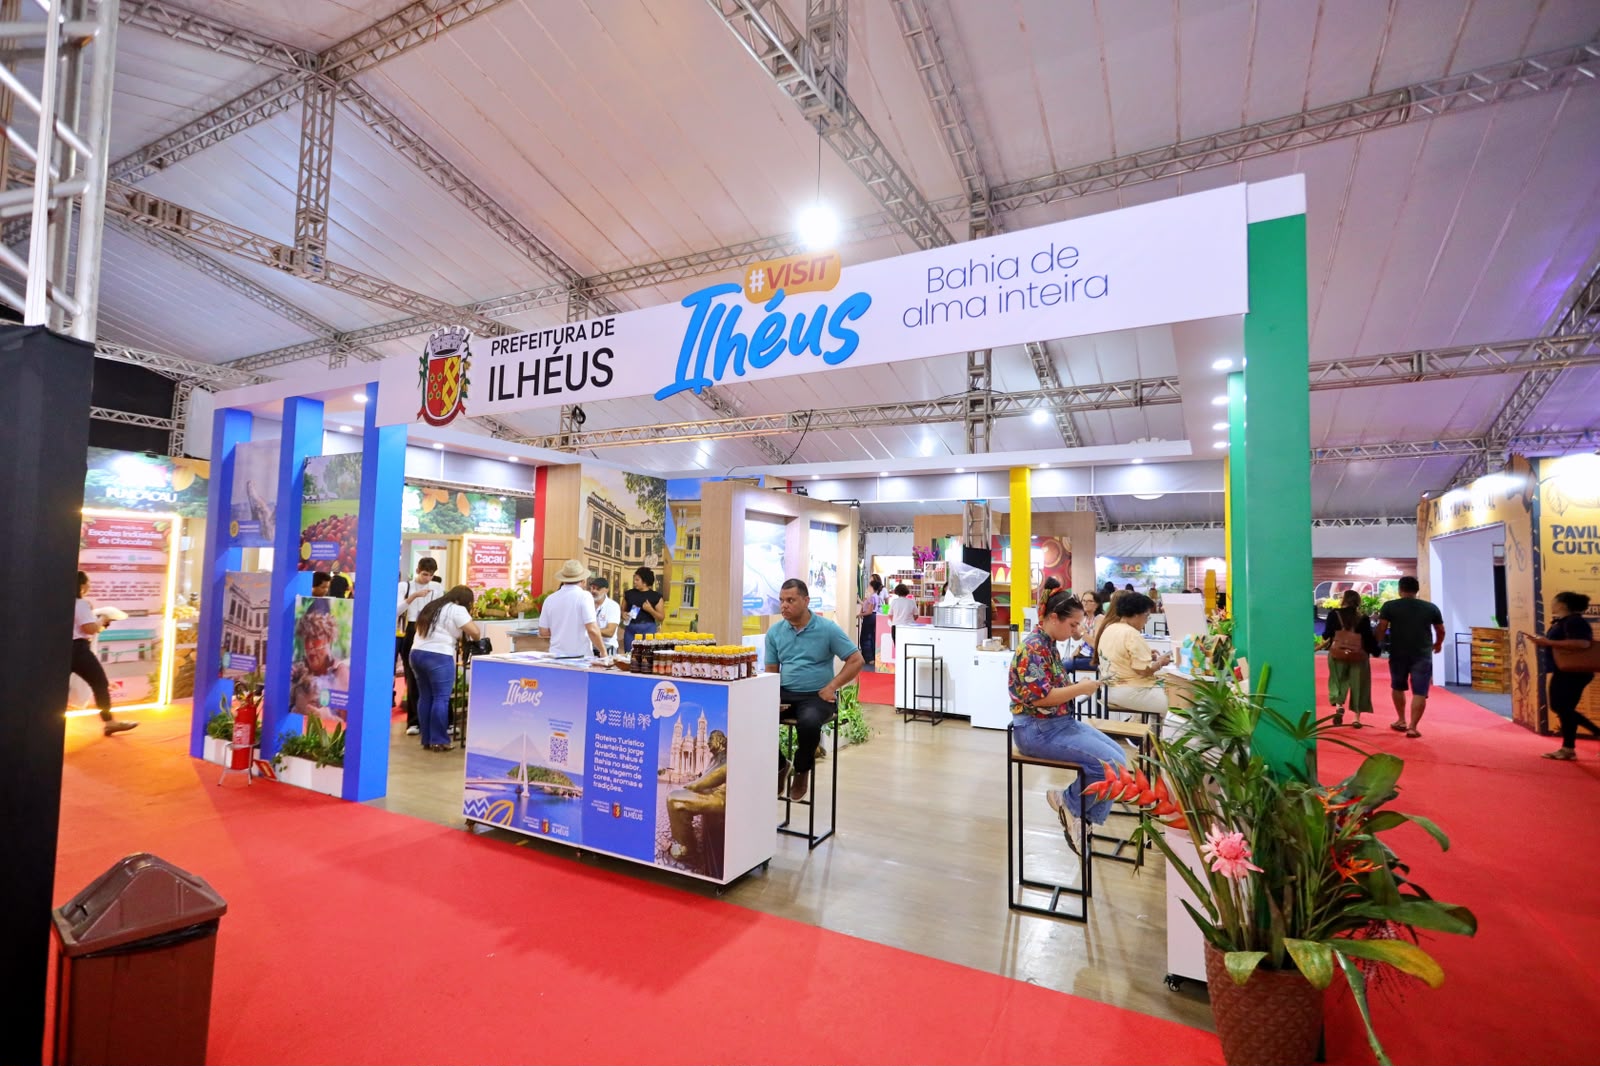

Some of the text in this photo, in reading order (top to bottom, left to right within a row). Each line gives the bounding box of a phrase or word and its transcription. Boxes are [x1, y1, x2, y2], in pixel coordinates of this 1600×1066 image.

[748, 255, 834, 294] #VISIT
[927, 242, 1079, 293] Bahia de
[903, 273, 1108, 328] alma inteira
[491, 318, 615, 356] PREFEITURA DE
[653, 283, 873, 401] Ilhéus
[488, 345, 614, 402] ILHÉUS
[474, 553, 506, 564] Cacau
[501, 679, 544, 706] Ilhéus
[654, 688, 677, 702] Ilhéus
[594, 741, 627, 753] Quarteirão
[595, 733, 645, 748] Roteiro Turístico
[594, 757, 611, 766] Bahia
[593, 765, 642, 780] Uma viagem de
[612, 777, 638, 787] aromas
